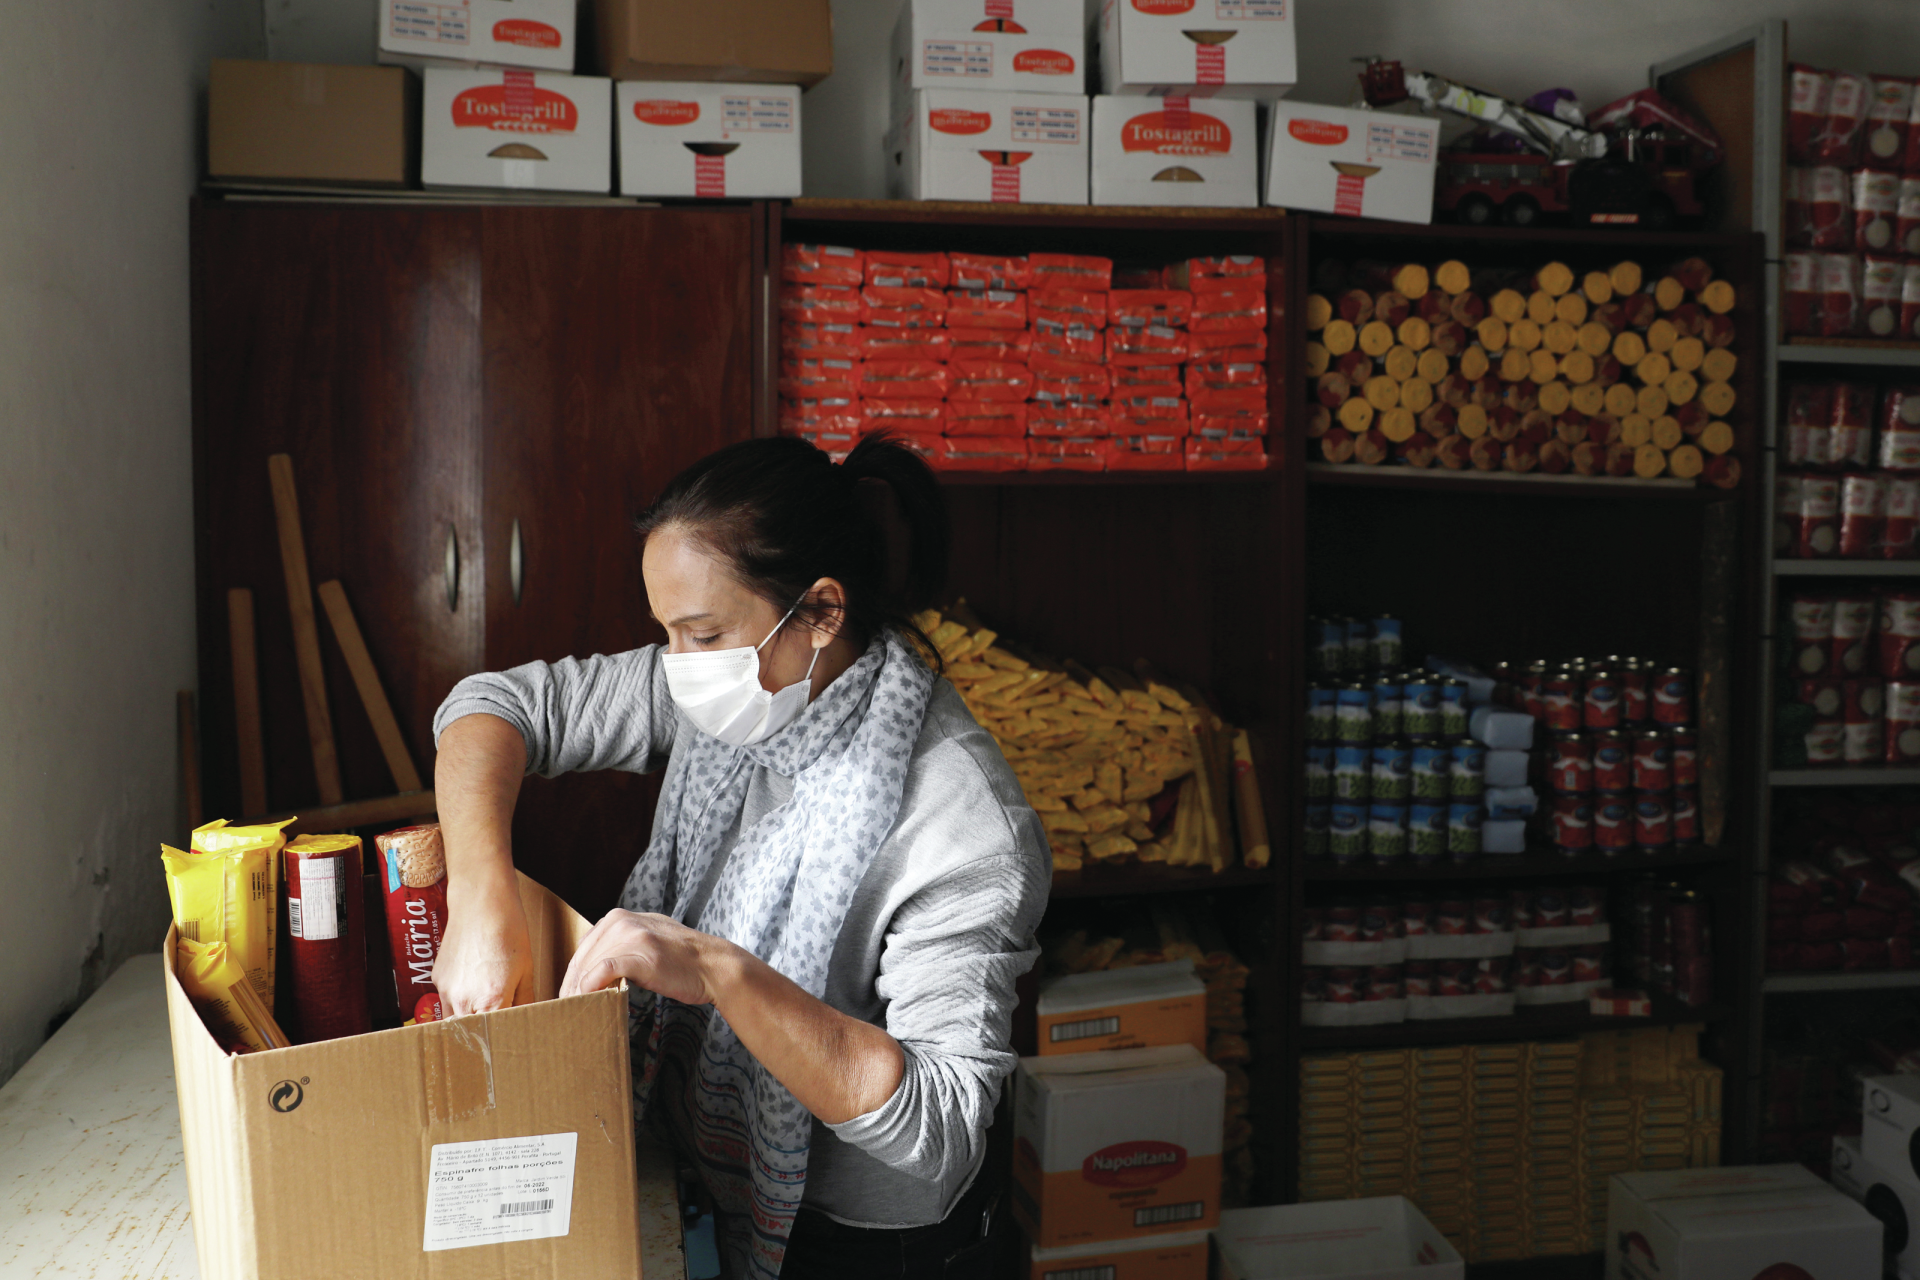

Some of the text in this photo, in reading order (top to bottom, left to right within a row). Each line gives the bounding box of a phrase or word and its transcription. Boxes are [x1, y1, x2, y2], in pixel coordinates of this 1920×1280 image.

[461, 97, 567, 122] Tostrill
[1128, 123, 1222, 146] Tostagrill
[401, 898, 435, 984] Maria
[404, 933, 412, 956] Bolacha
[435, 1168, 484, 1176] Espinafre
[523, 1160, 564, 1169] porções
[1092, 1151, 1177, 1172] Napolitana
